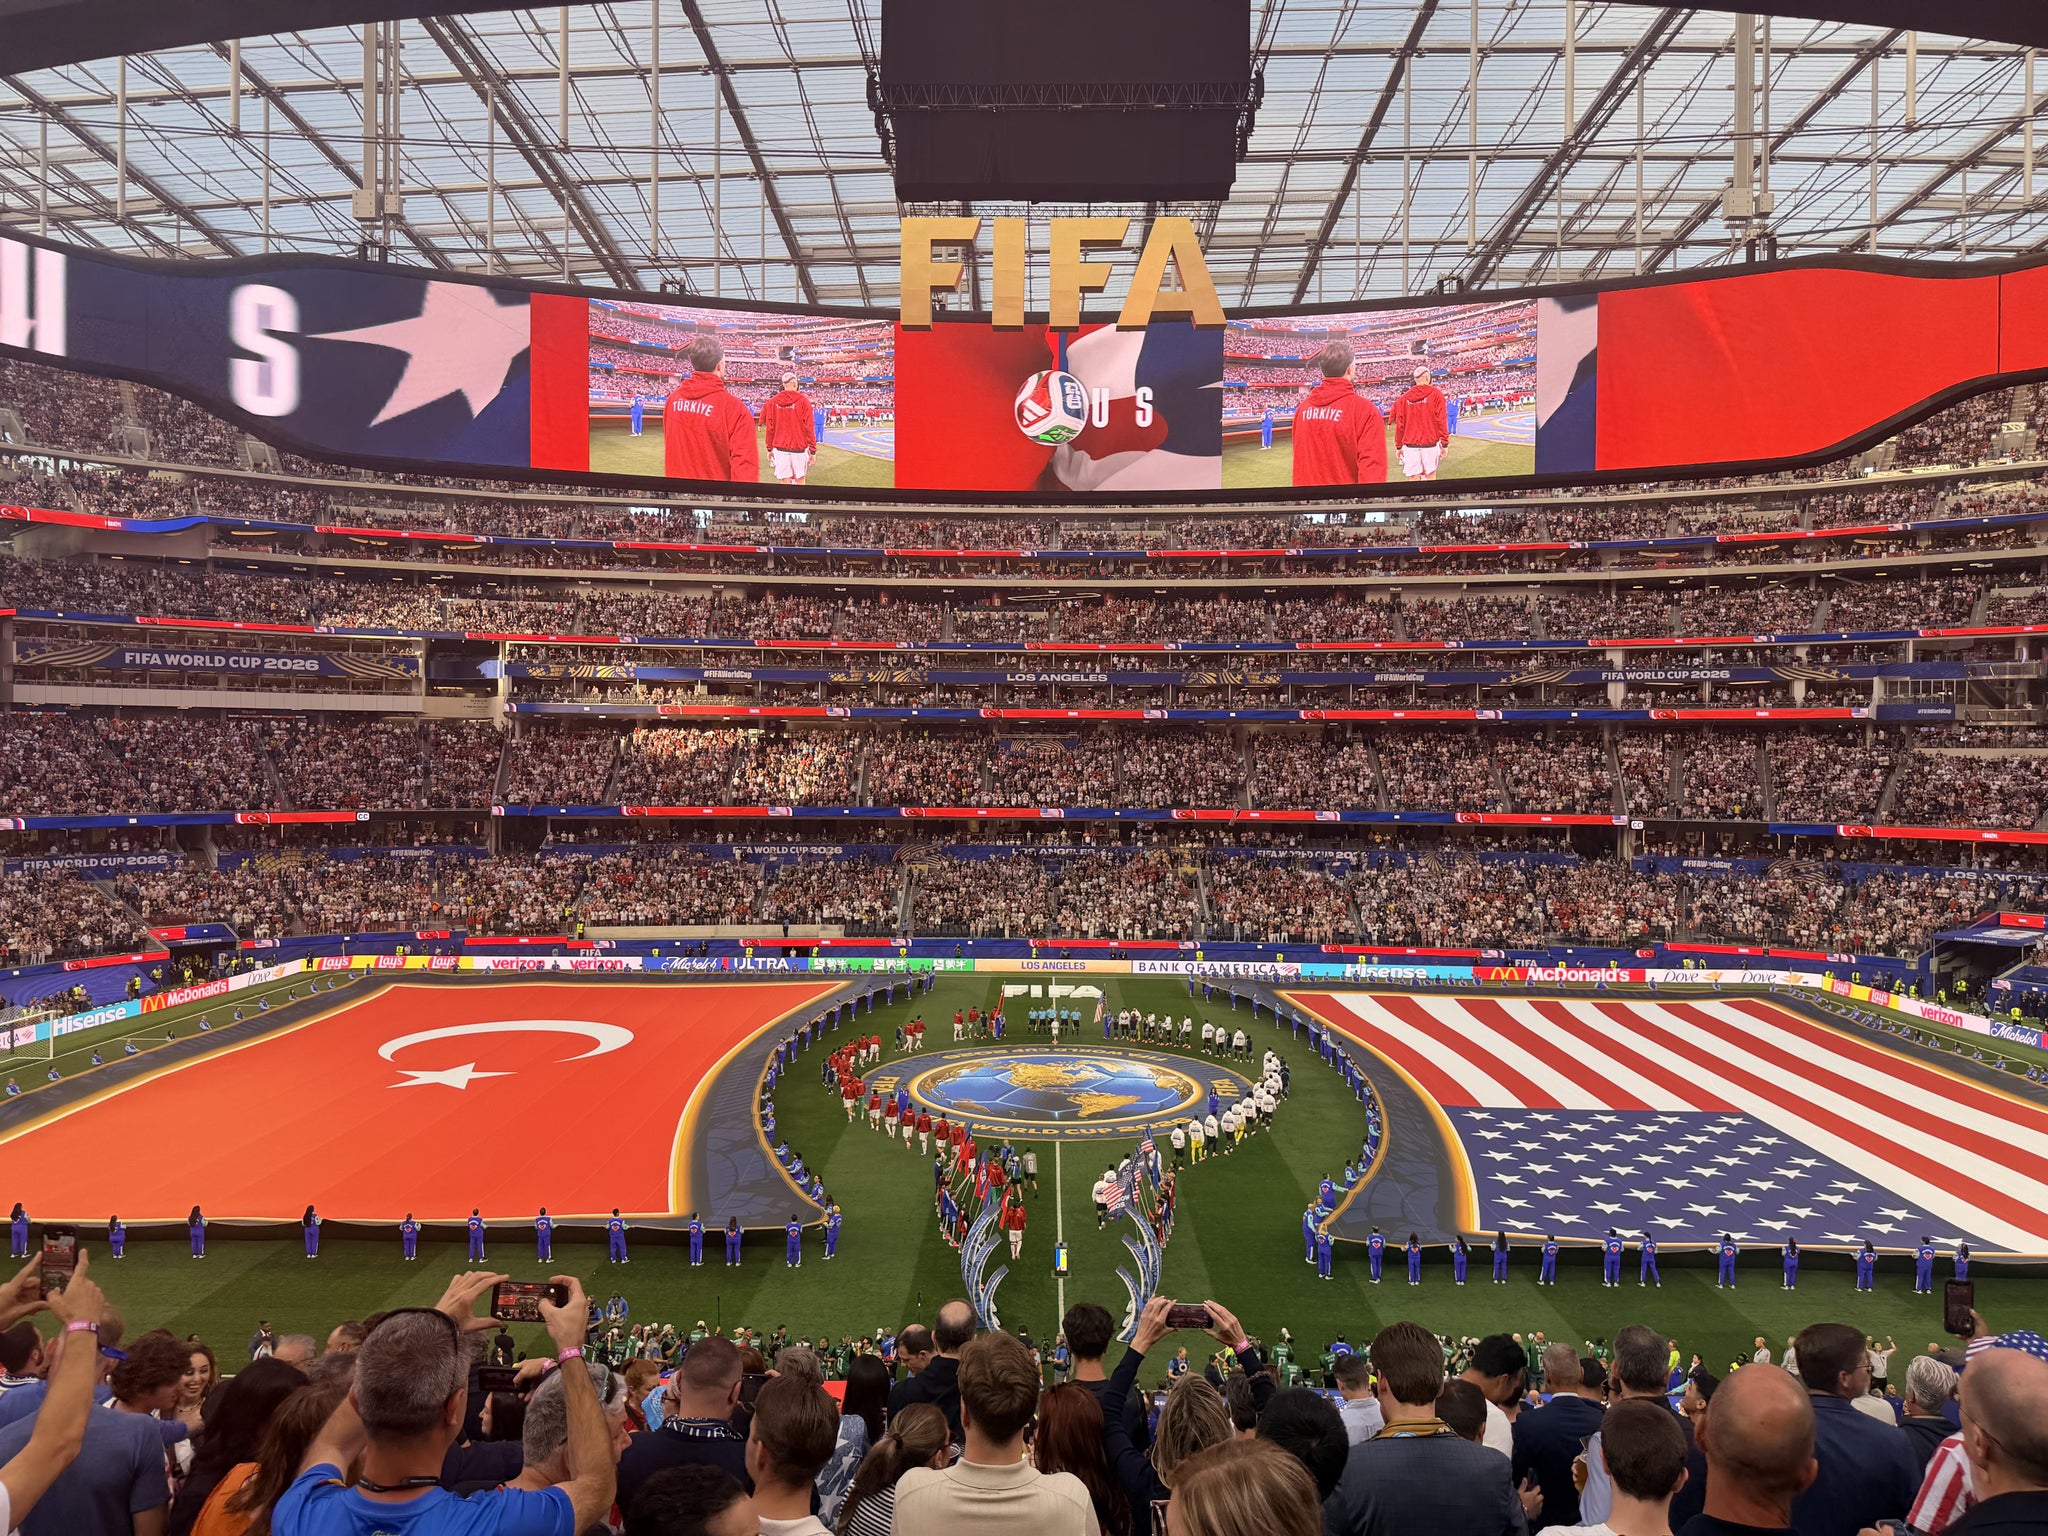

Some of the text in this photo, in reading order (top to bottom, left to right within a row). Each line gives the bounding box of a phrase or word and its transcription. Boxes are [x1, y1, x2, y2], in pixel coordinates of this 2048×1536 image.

[900, 217, 1227, 331] FIFA
[230, 284, 300, 417] S
[672, 399, 714, 417] TÜRKİYE
[1302, 407, 1343, 422] TÜRKİYE
[124, 652, 320, 671] FIFA WORLD CUP 2026
[703, 670, 752, 680] #FIFAWorldCup
[1006, 674, 1108, 682] LOS ANGELES
[1374, 673, 1425, 683] #FIFAWorldCup
[1601, 670, 1730, 681] FIFA WORLD CUP 2026
[754, 846, 788, 854] WORLD
[23, 855, 168, 870] FIFA WORLD CUP 2026
[1944, 870, 1978, 880] LOS
[580, 949, 602, 957] FIFA
[322, 956, 349, 970] Lay's
[380, 955, 405, 969] Lay's
[432, 955, 457, 969] Lay's
[492, 957, 545, 969] verizon
[570, 957, 623, 969] verizon
[734, 958, 789, 970] ULTRA
[1021, 961, 1086, 970] LOS ANGELES
[1139, 962, 1279, 975] BANK OF AMERICA
[1515, 959, 1537, 967] FIFA
[1345, 963, 1428, 979] Hisense
[1526, 967, 1631, 982] McDonald's
[1663, 969, 1700, 983] Dove
[1740, 970, 1777, 983] Dove
[248, 972, 271, 986] Dove
[167, 979, 227, 1007] McDonald's
[1001, 984, 1103, 998] FIFA
[1832, 981, 1850, 995] Lay's
[1871, 988, 1890, 1005] Lay's
[53, 1006, 127, 1037] Hisense
[1920, 1005, 1964, 1028] verizon
[1990, 1022, 2038, 1046] Michelob
[971, 1116, 1193, 1136] WORLD CUP 2026
